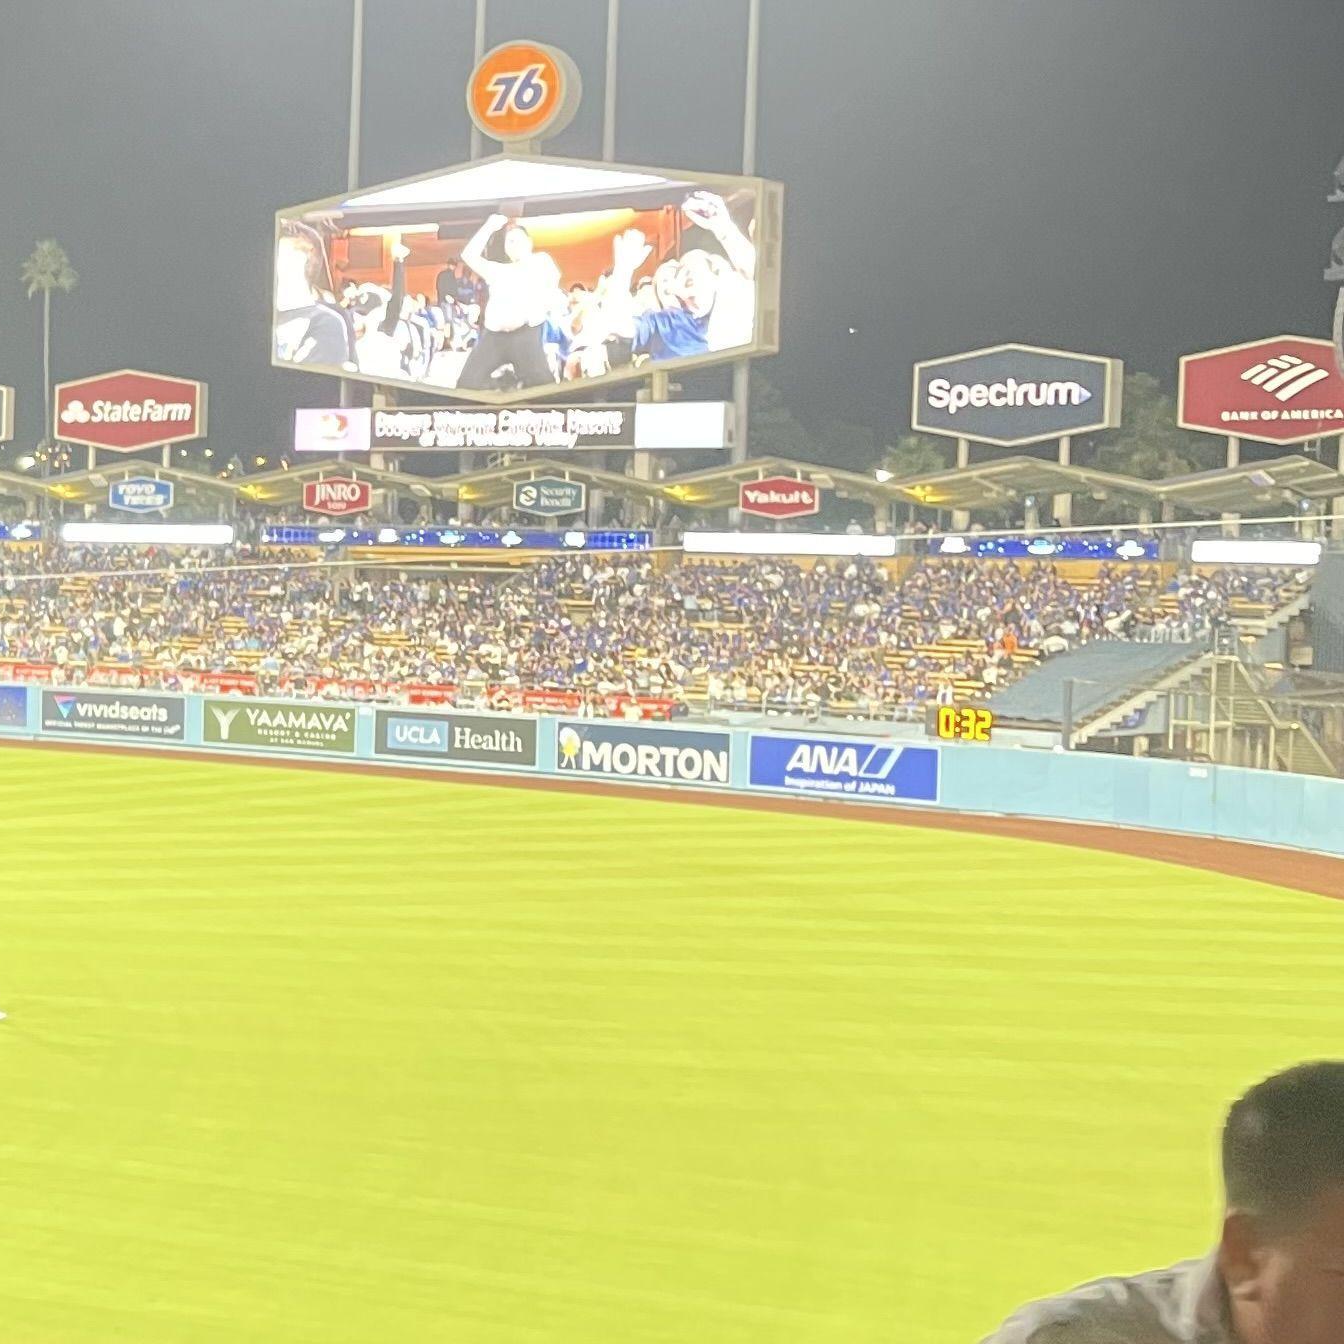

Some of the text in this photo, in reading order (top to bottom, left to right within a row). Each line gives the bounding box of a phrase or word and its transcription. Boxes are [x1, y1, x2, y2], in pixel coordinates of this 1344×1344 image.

[487, 64, 546, 116] 76
[928, 378, 1081, 414] Spectrum
[1220, 408, 1344, 422] BANK OF AMERICA
[314, 483, 361, 505] JINRO
[744, 490, 814, 505] Yakult
[76, 701, 168, 722] vividseats
[938, 707, 992, 741] 0:32
[395, 725, 523, 753] UCLA Health
[582, 741, 729, 783] MORTON
[785, 744, 860, 777] ANA
[858, 781, 896, 796] JAPAN
